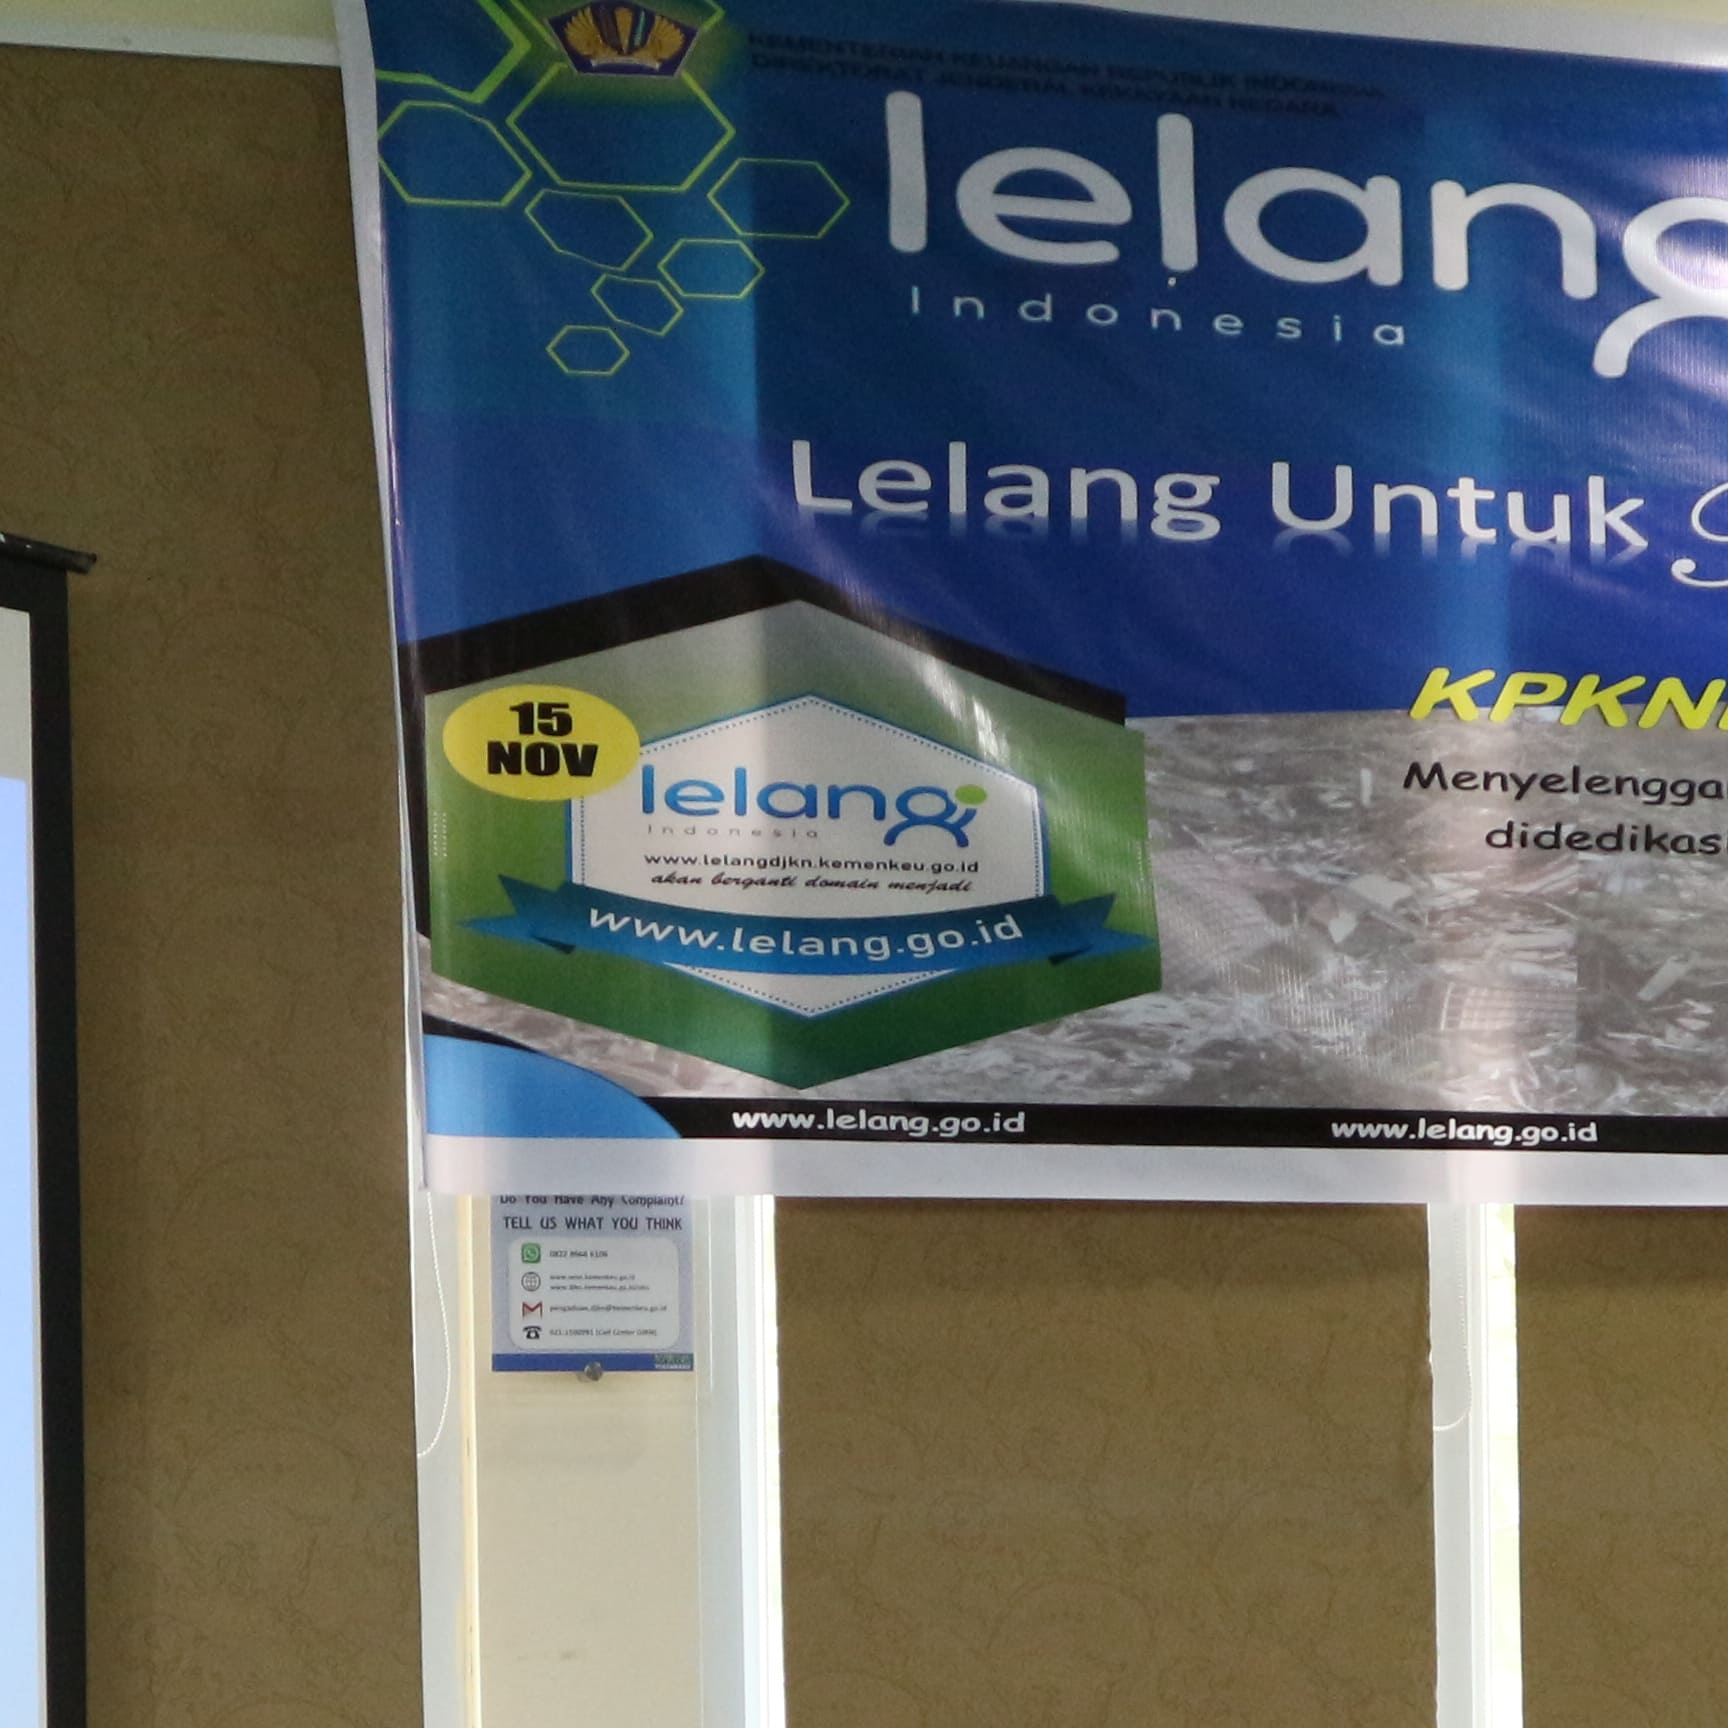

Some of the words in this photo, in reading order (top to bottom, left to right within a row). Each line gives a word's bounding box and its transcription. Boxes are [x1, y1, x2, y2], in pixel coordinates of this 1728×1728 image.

[910, 284, 1405, 347] Indonesia
[792, 438, 1223, 541] Lelang
[1271, 460, 1649, 548] Untuk
[508, 700, 575, 738] 15
[487, 743, 599, 778] NOV
[641, 763, 986, 848] lelang
[647, 823, 820, 839] Indonesia
[644, 851, 980, 875] www.lelangdjkn.kemenkeu.go.id
[652, 872, 704, 887] akan
[710, 870, 798, 890] berganti
[805, 874, 880, 891] domain
[888, 877, 974, 895] menjadi
[588, 906, 1023, 963] www.lelang.go.id
[731, 1106, 1027, 1138] www.lelang.go.id
[1330, 1116, 1599, 1148] www.lelang.go.id
[504, 1216, 532, 1230] TELL
[540, 1216, 557, 1230] US
[565, 1216, 604, 1230] WHAT
[612, 1217, 638, 1230] YOU
[646, 1217, 683, 1230] THINK
